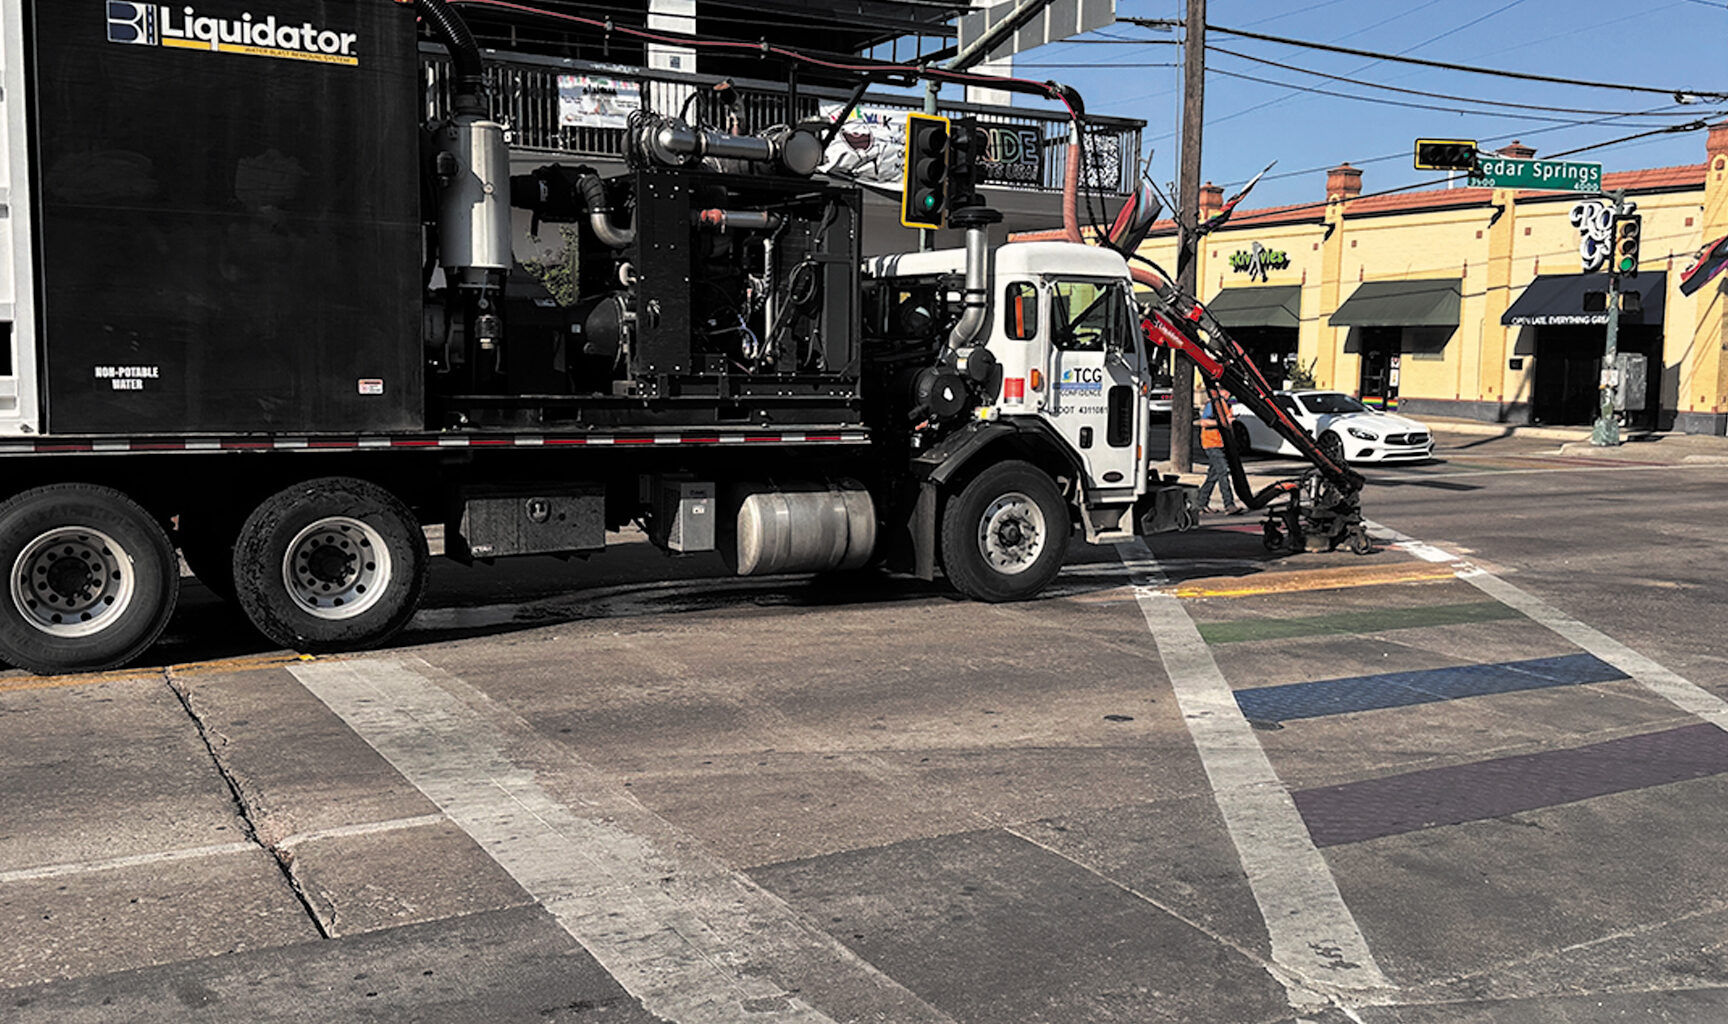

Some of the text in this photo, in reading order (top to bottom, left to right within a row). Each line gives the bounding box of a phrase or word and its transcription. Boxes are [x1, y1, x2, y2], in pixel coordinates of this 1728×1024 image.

[160, 6, 357, 55] Liquidator
[1478, 160, 1598, 182] edar Springs
[1549, 316, 1590, 325] EVERYTHING
[1591, 315, 1610, 325] GREA
[95, 366, 159, 378] NON-POTABLE
[1074, 368, 1102, 383] TCG
[112, 379, 143, 390] WATER
